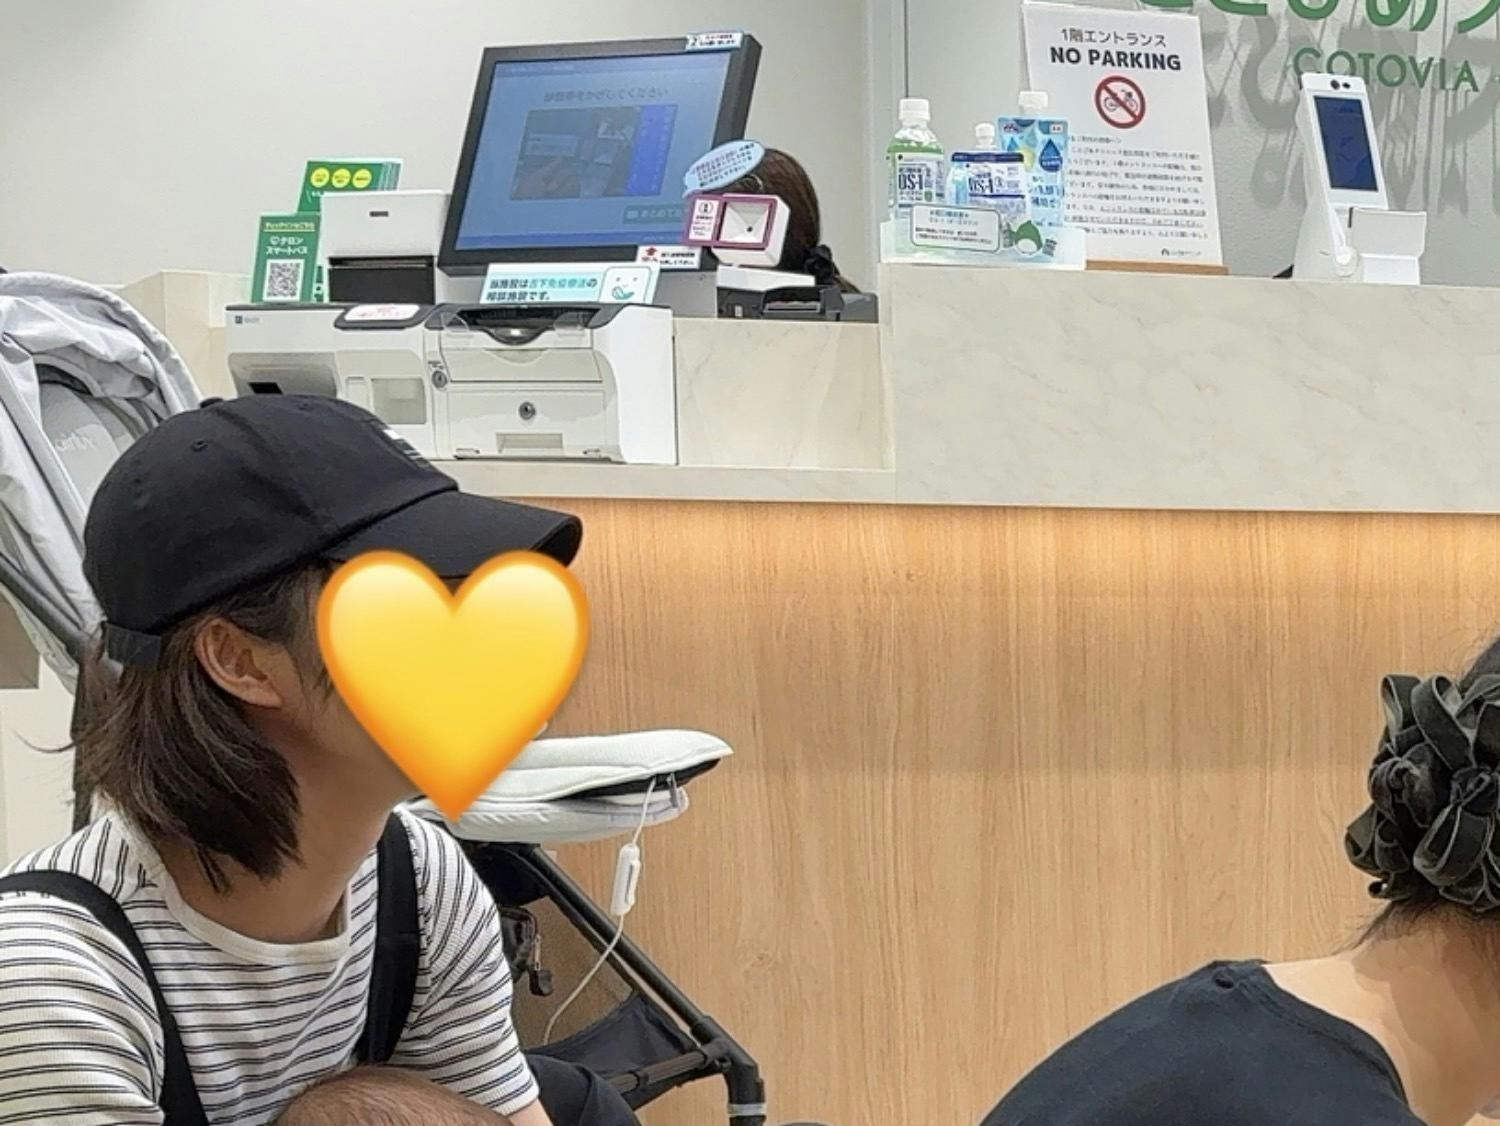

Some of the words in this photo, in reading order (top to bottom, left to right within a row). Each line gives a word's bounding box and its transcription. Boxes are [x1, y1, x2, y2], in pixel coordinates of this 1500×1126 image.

[1061, 28, 1166, 48] 1階エントランス
[1050, 46, 1081, 64] NO
[1088, 49, 1181, 71] PARKING
[1293, 47, 1478, 92] COTOVIA
